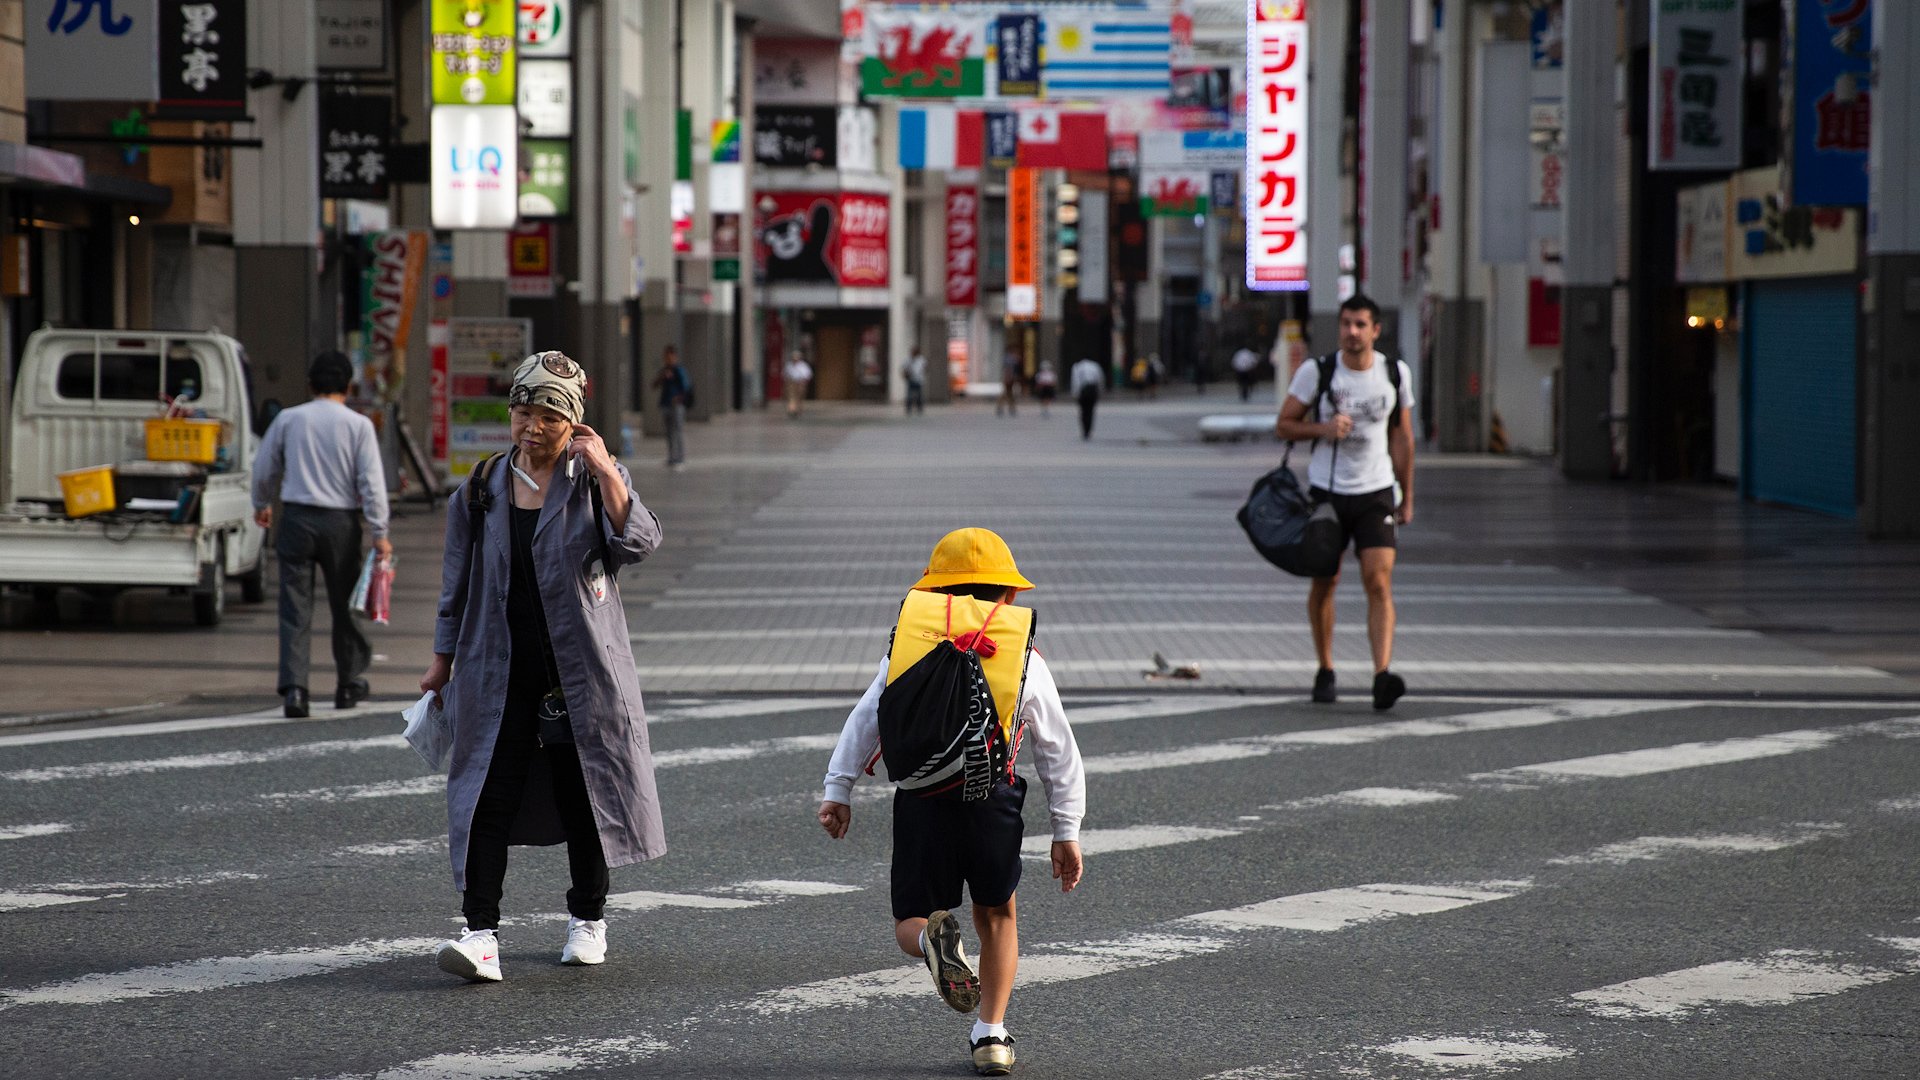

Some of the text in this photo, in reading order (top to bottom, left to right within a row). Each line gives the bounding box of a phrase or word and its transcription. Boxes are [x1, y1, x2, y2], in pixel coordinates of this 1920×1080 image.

[181, 3, 219, 92] 黒亭
[450, 145, 503, 176] UQ
[1259, 30, 1297, 256] ジャンカラ
